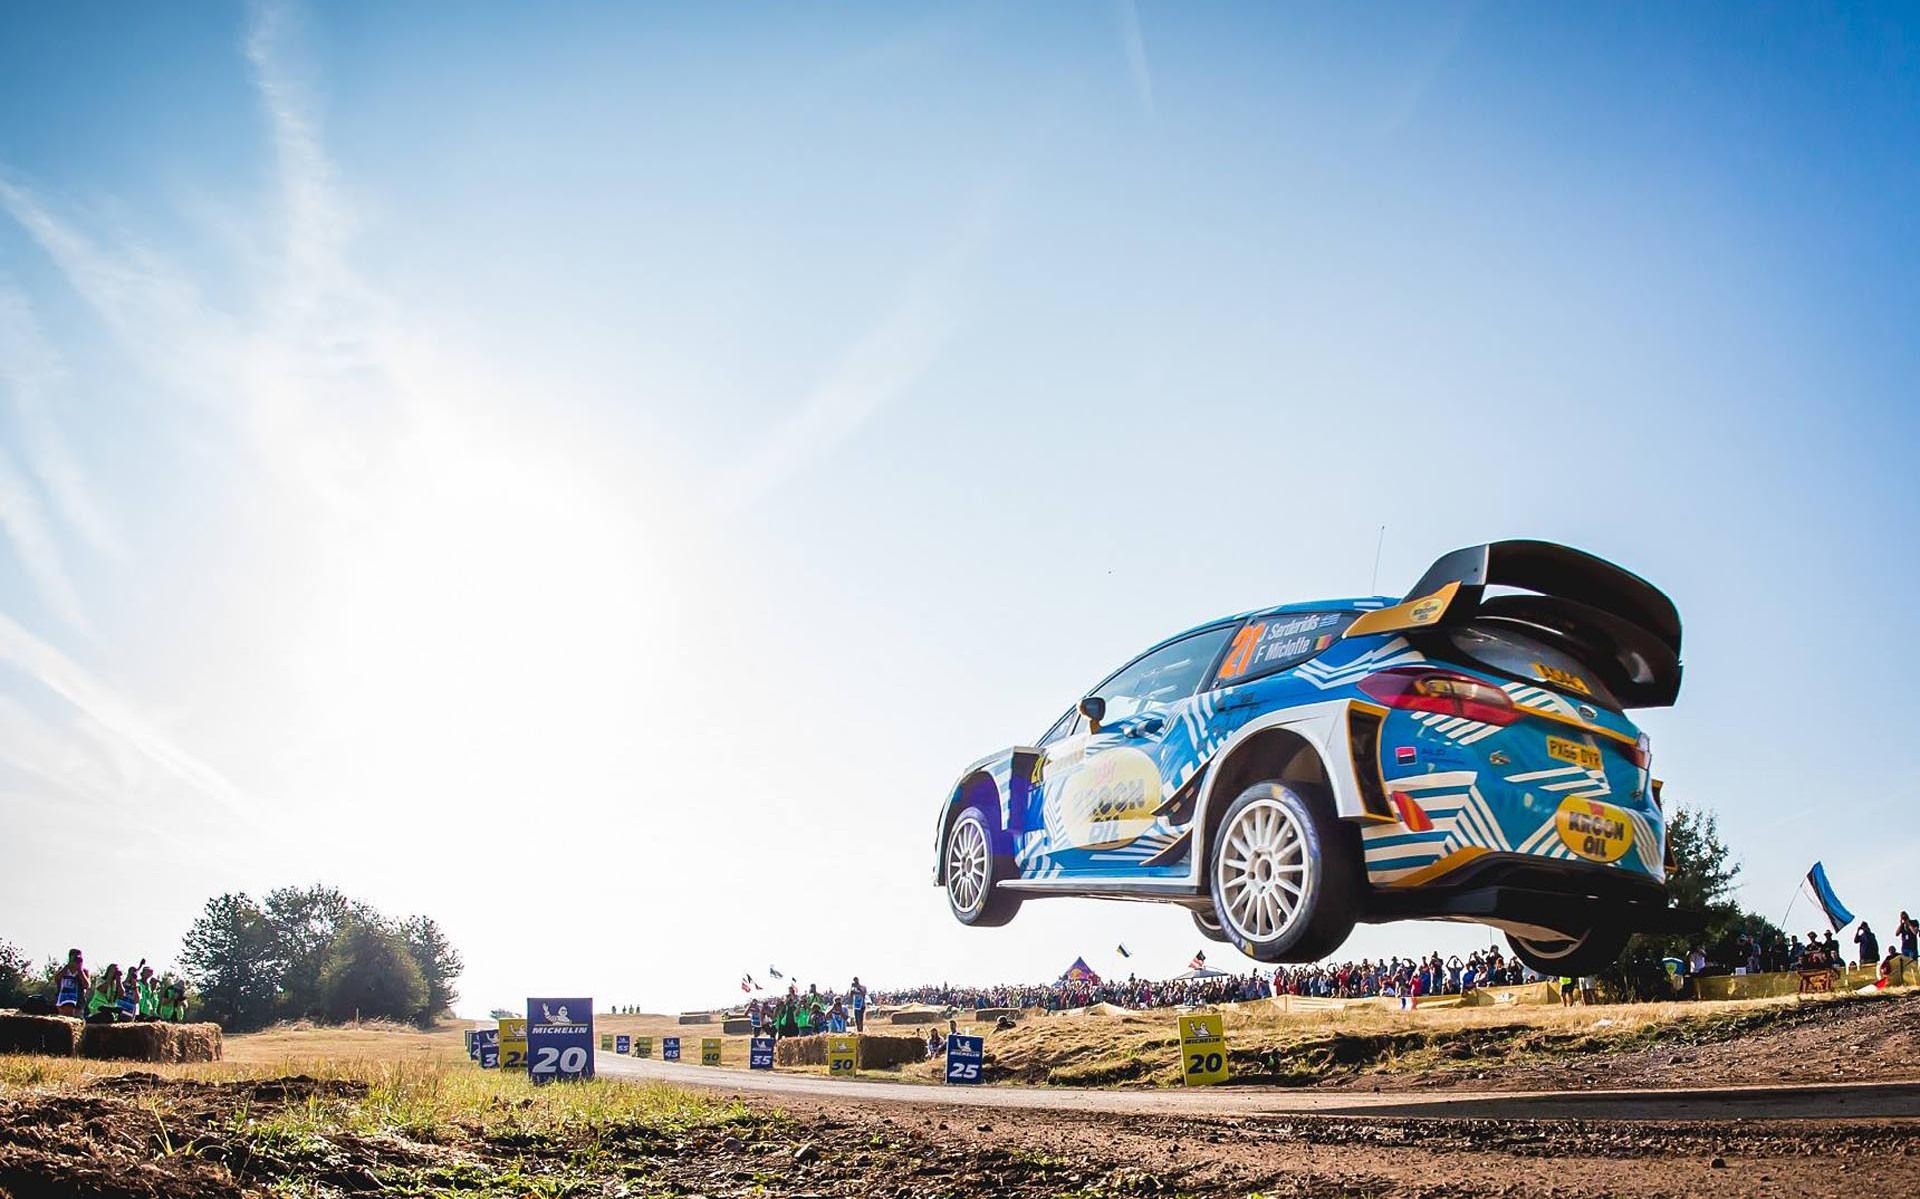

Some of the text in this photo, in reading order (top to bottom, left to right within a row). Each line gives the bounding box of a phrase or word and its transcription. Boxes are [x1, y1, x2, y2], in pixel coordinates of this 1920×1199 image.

[1257, 614, 1320, 643] J Serderidis
[1218, 622, 1267, 679] 21
[1254, 636, 1311, 664] F Miclotte
[1569, 811, 1624, 841] KROON
[1583, 835, 1606, 857] OIL
[532, 1047, 588, 1073] 20
[664, 1049, 679, 1058] 45
[703, 1053, 720, 1061] 40
[751, 1055, 772, 1065] 35
[831, 1059, 854, 1070] 30
[1188, 1052, 1223, 1074] 20
[949, 1062, 979, 1079] 25
